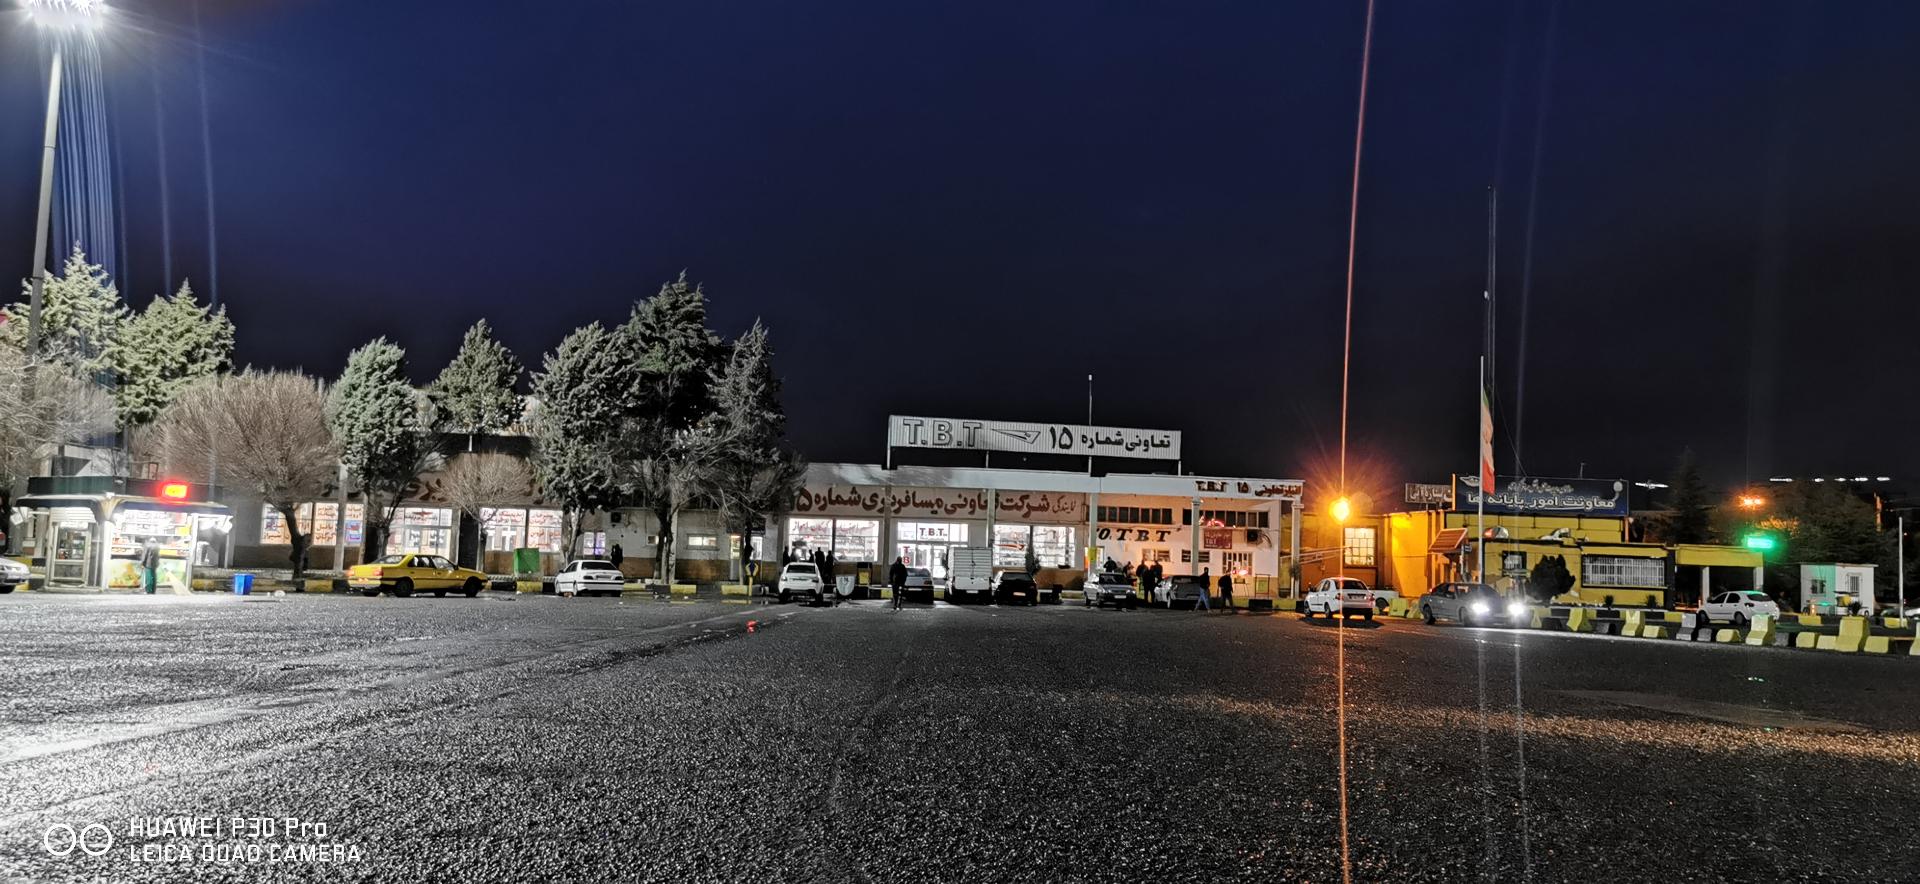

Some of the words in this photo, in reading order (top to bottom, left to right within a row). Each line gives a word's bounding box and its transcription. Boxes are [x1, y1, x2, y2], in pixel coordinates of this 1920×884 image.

[903, 418, 983, 448] T.B.T
[1049, 425, 1074, 450] ۱۵
[1081, 430, 1125, 449] شماره
[1124, 433, 1171, 452] تعاونی
[814, 486, 862, 511] شماره
[1000, 493, 1050, 518] شرکت
[1487, 493, 1525, 510] پایانه
[1529, 495, 1559, 510] امور
[1562, 496, 1615, 511] معاونت
